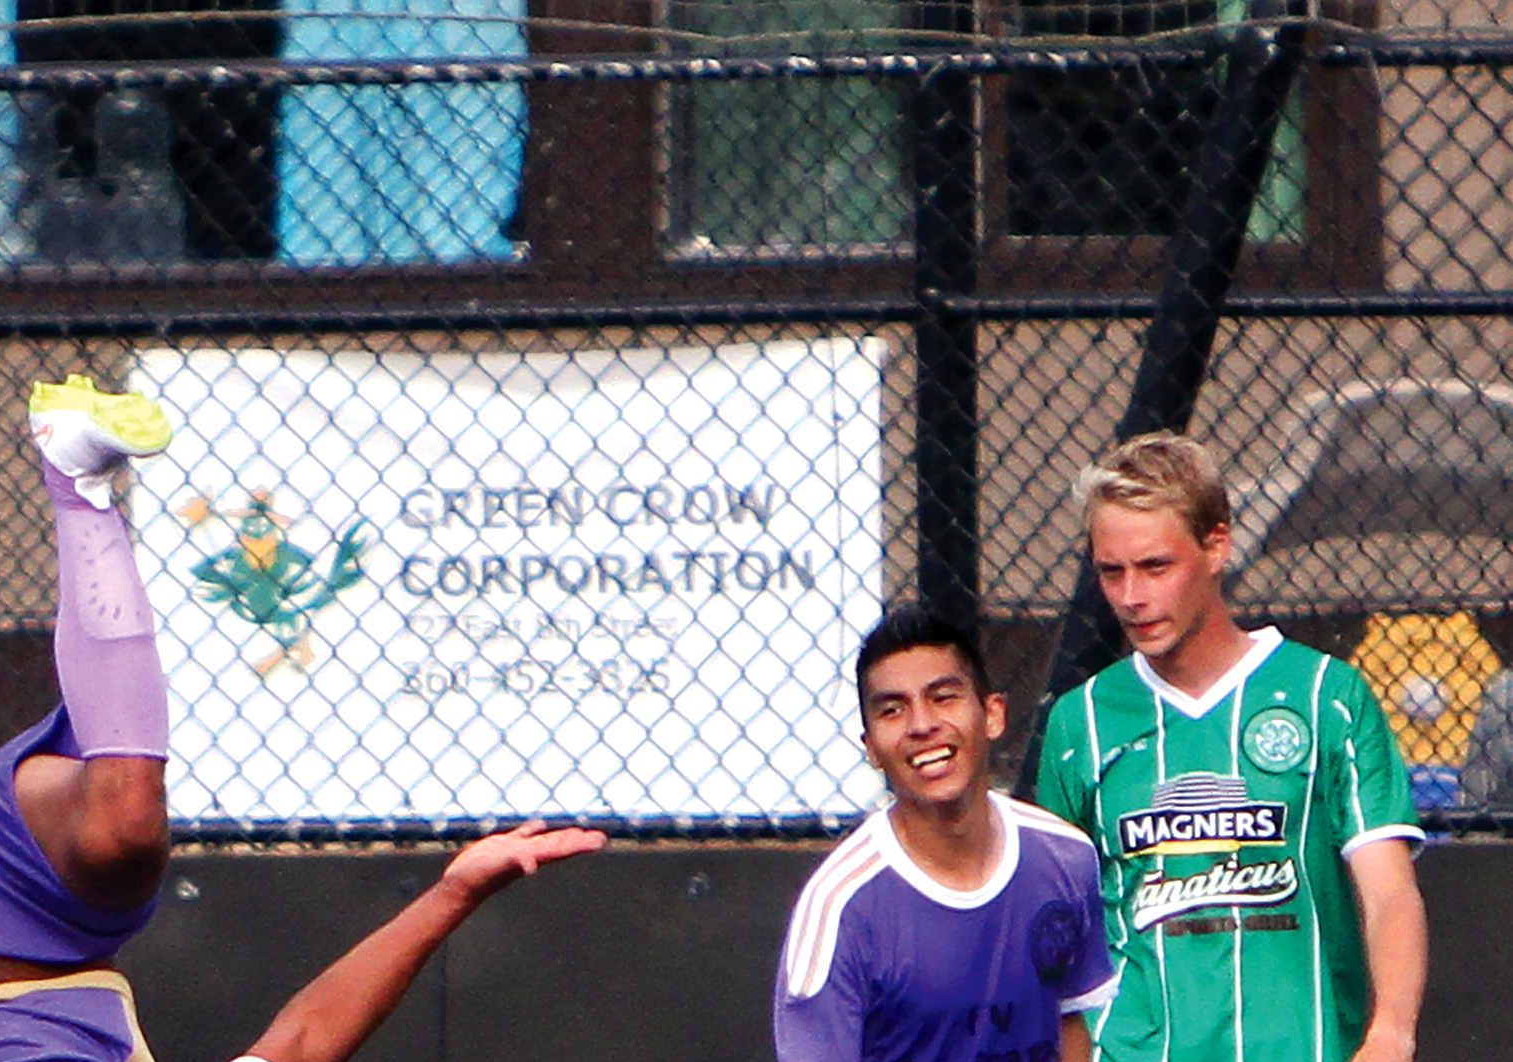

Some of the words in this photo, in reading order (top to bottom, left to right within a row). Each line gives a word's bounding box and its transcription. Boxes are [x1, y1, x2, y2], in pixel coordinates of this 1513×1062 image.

[400, 486, 587, 530] GREEN
[603, 483, 777, 527] CROW
[400, 550, 817, 598] CORPORATION
[1126, 808, 1277, 848] MAGNERS
